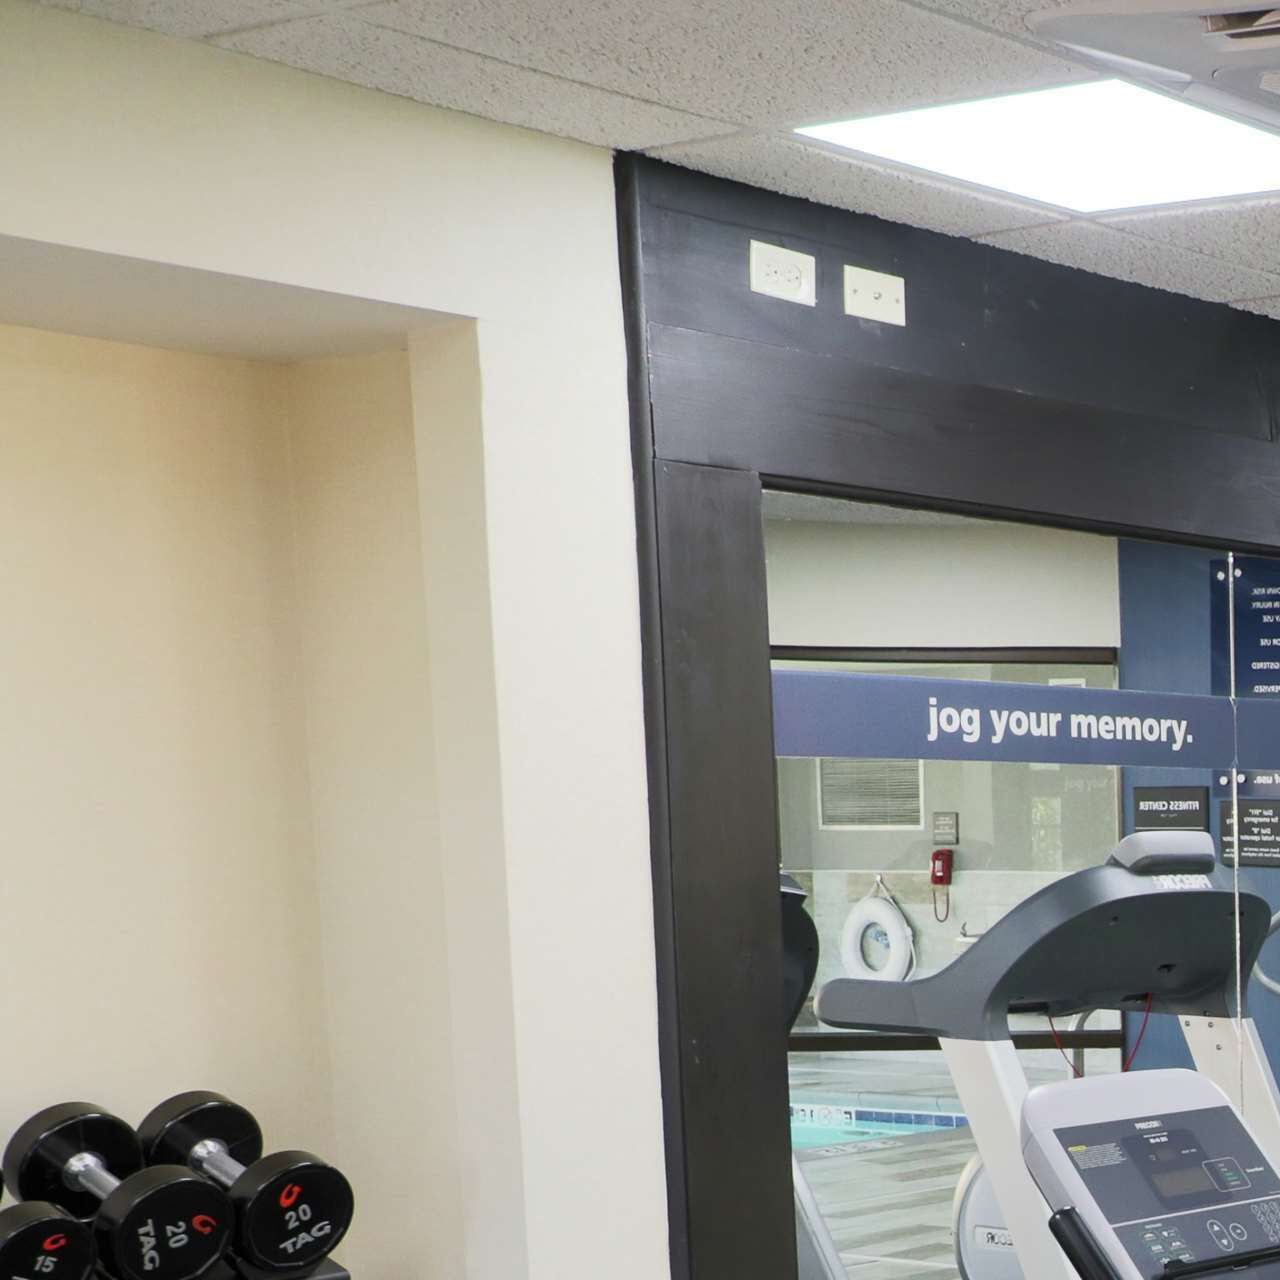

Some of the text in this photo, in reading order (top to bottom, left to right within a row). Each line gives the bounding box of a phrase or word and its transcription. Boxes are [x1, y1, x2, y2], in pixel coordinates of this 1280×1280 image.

[927, 697, 1193, 751] jog your memory.
[284, 1203, 312, 1230] 20
[137, 1218, 159, 1270] TAG
[165, 1221, 188, 1248] 20
[279, 1220, 332, 1253] TAG
[34, 1255, 57, 1273] 15
